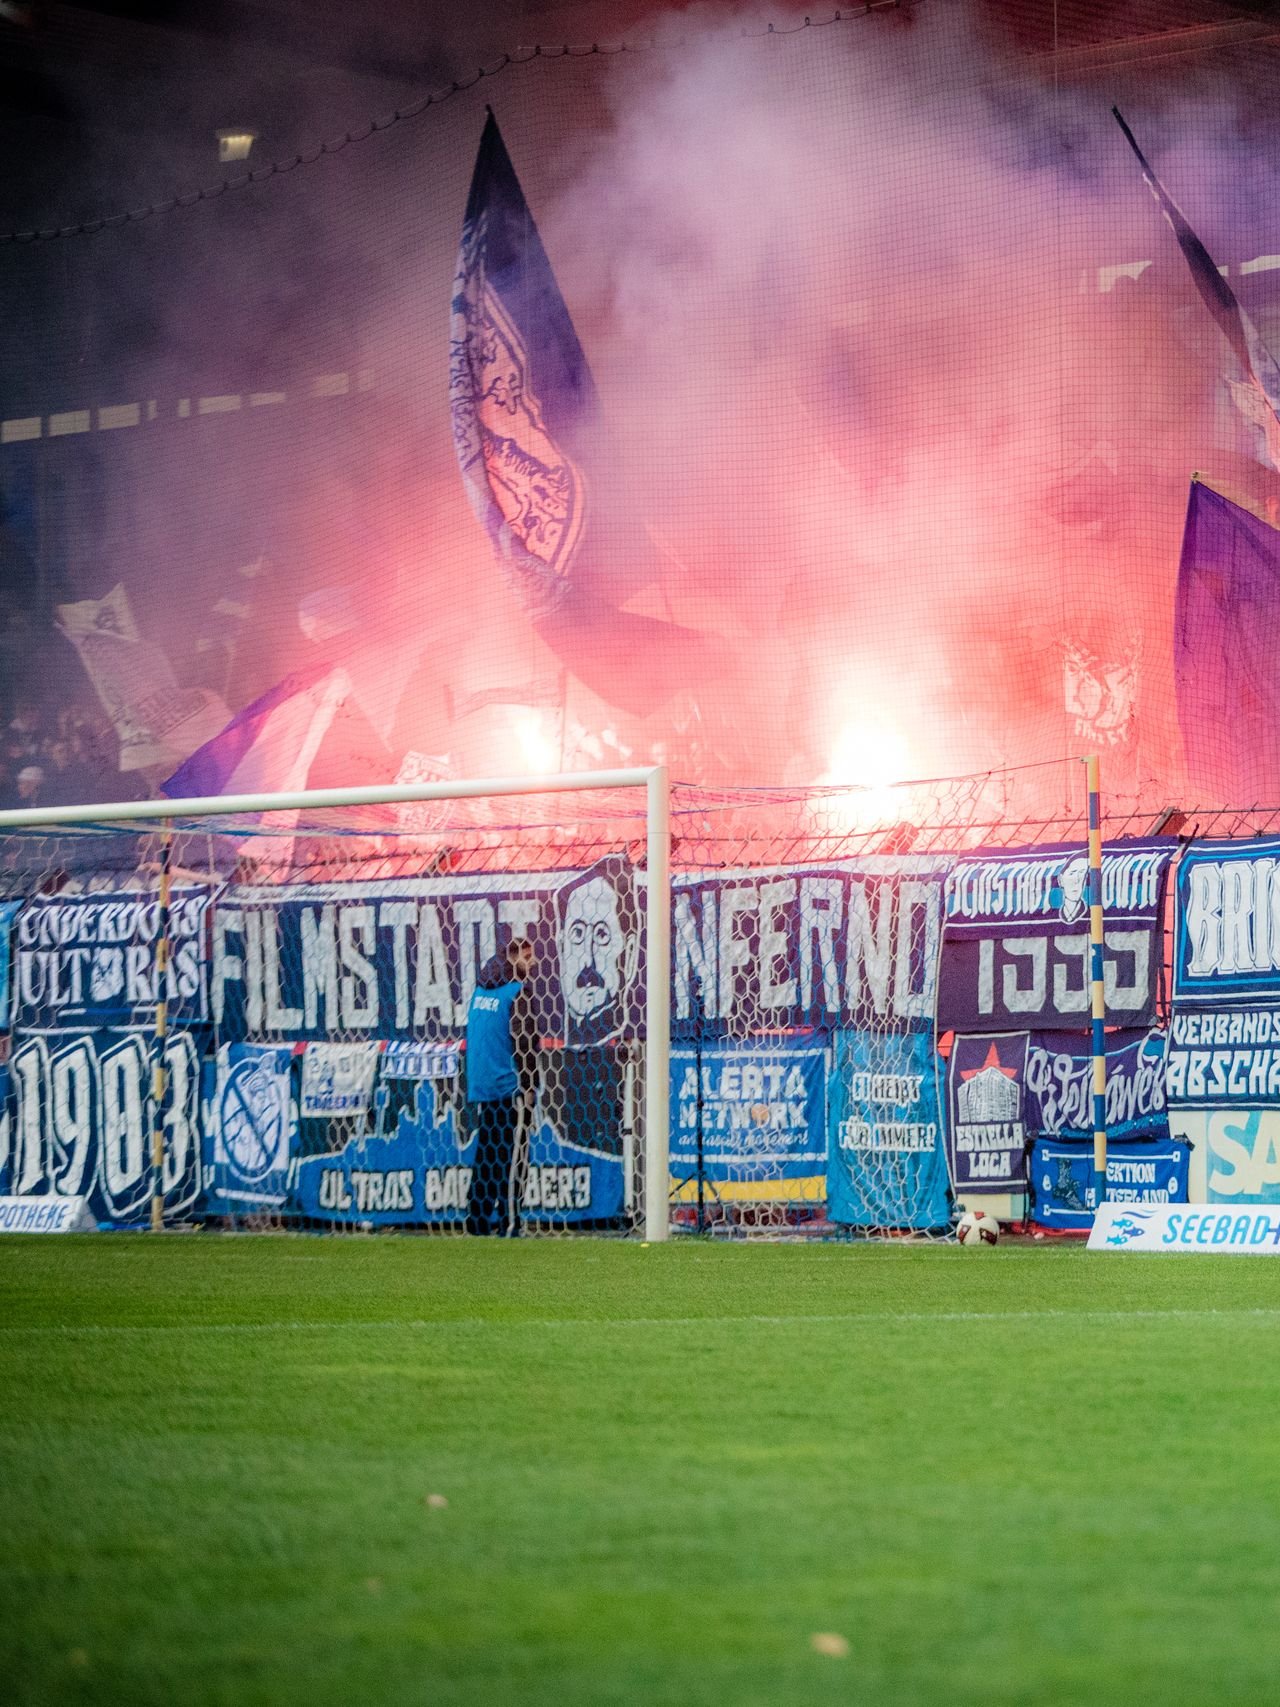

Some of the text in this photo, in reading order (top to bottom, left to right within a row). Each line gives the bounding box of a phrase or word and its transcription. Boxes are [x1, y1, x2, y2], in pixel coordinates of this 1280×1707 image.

[672, 878, 943, 1022] NFERNO
[679, 1065, 808, 1100] ALERTA
[679, 1100, 809, 1129] NETWORK
[955, 1122, 1025, 1151] ESTRELLA
[968, 1151, 1012, 1178] LOCA
[1105, 1162, 1156, 1184] EKTION
[319, 1168, 415, 1211] ULTRAS
